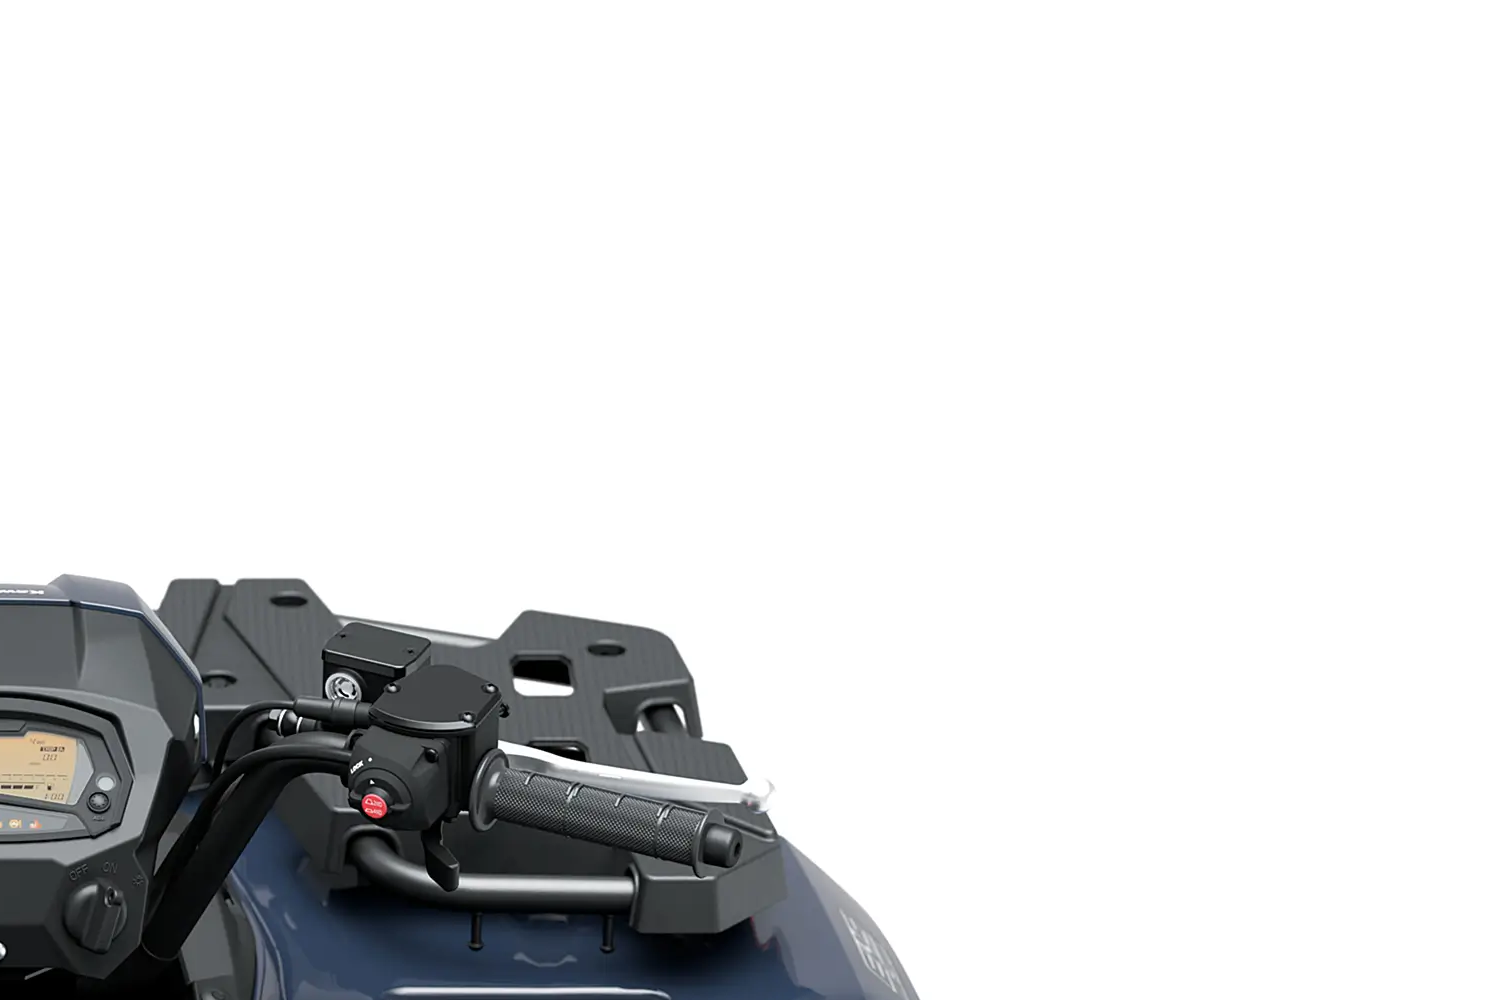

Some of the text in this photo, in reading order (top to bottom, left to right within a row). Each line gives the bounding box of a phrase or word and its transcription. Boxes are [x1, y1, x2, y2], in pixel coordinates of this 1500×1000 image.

[350, 760, 364, 774] LOCK
[69, 863, 88, 880] OFF
[103, 861, 117, 873] ON
